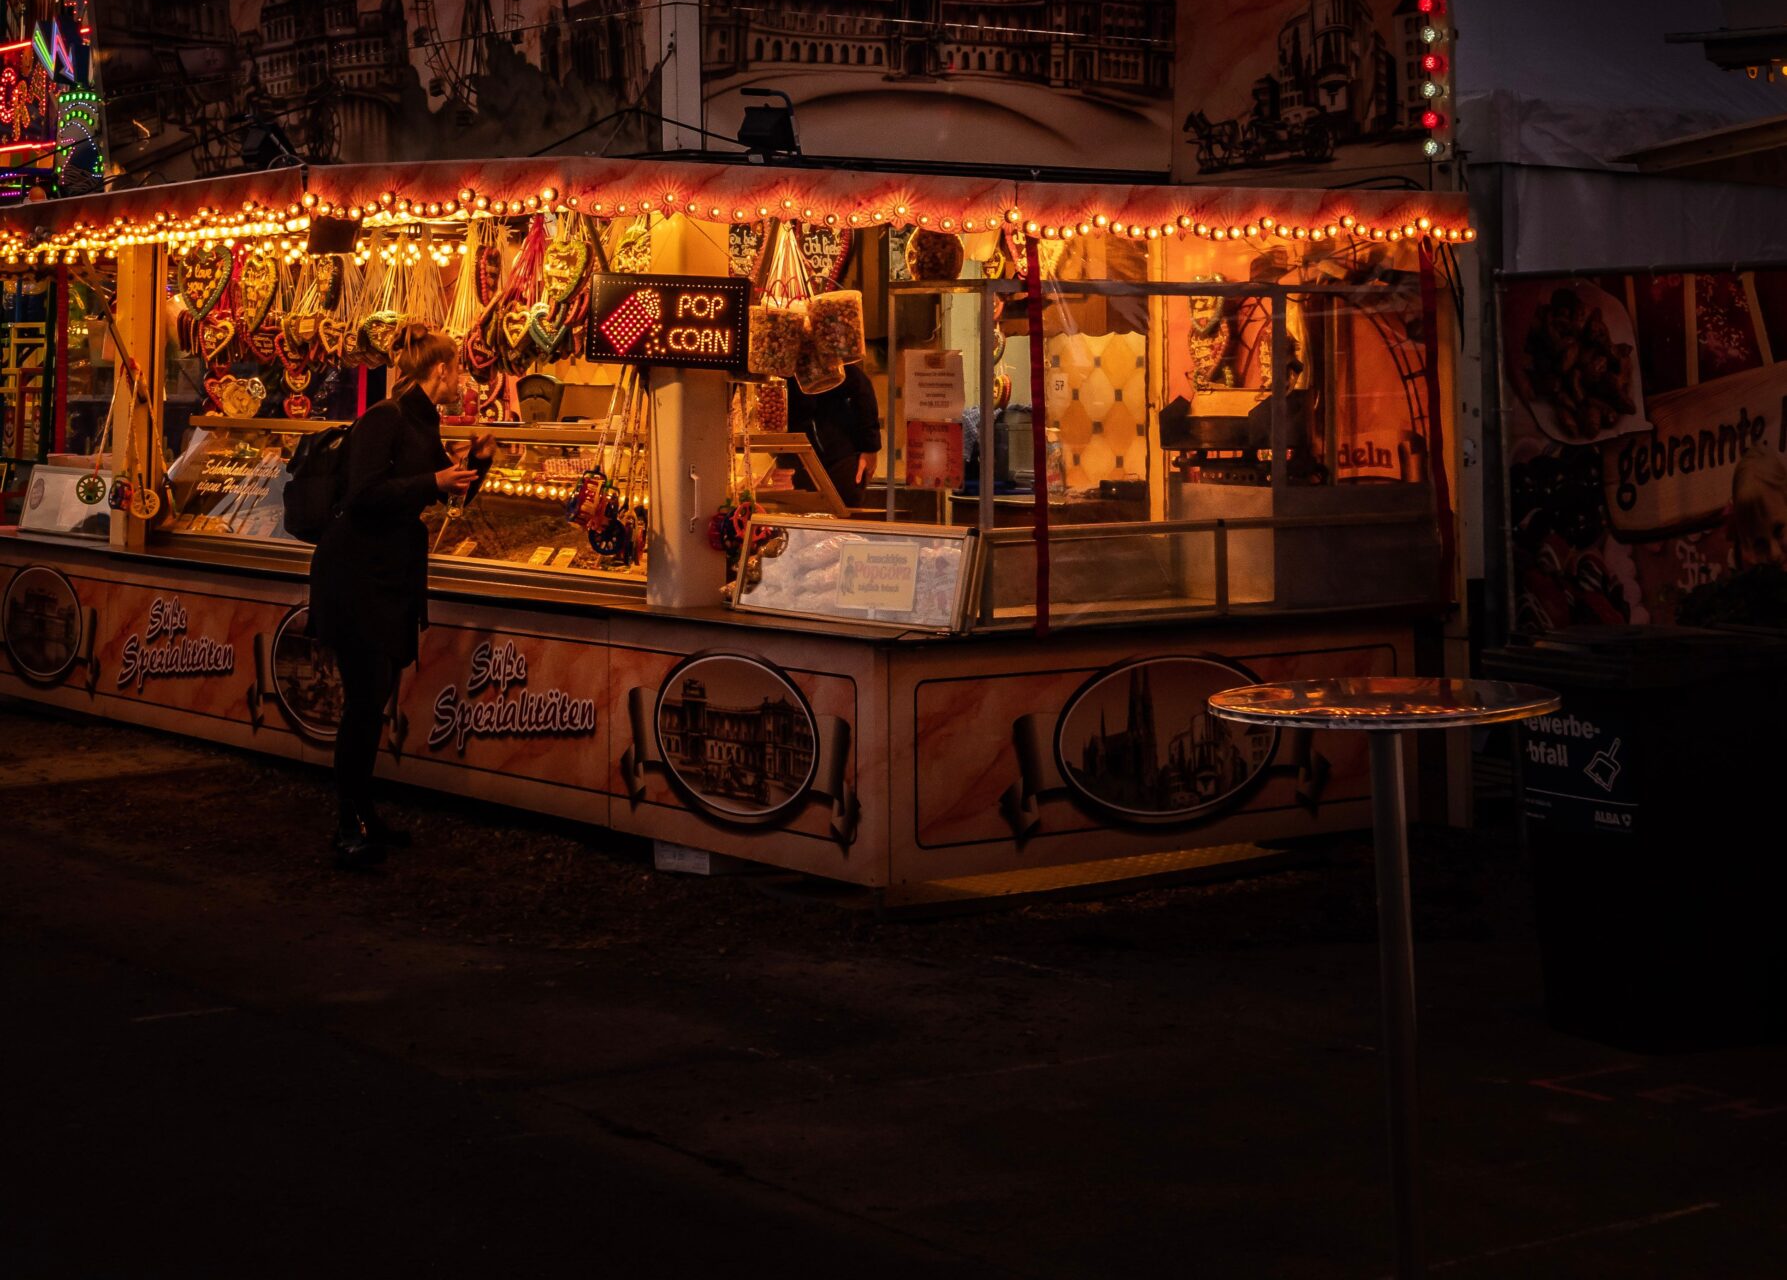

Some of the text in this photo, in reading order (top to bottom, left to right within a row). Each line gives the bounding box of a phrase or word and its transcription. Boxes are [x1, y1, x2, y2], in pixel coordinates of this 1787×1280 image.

[194, 263, 213, 279] love
[187, 281, 204, 295] you
[677, 293, 725, 319] POP
[668, 327, 731, 354] CORN
[854, 561, 912, 581] Popcorn
[145, 595, 187, 640] Süße
[117, 633, 234, 689] Spezialitäten
[466, 639, 527, 692] Süße
[427, 684, 595, 751] Spezialitäten
[1522, 711, 1601, 740] ewerbe-
[1526, 739, 1569, 769] bfall
